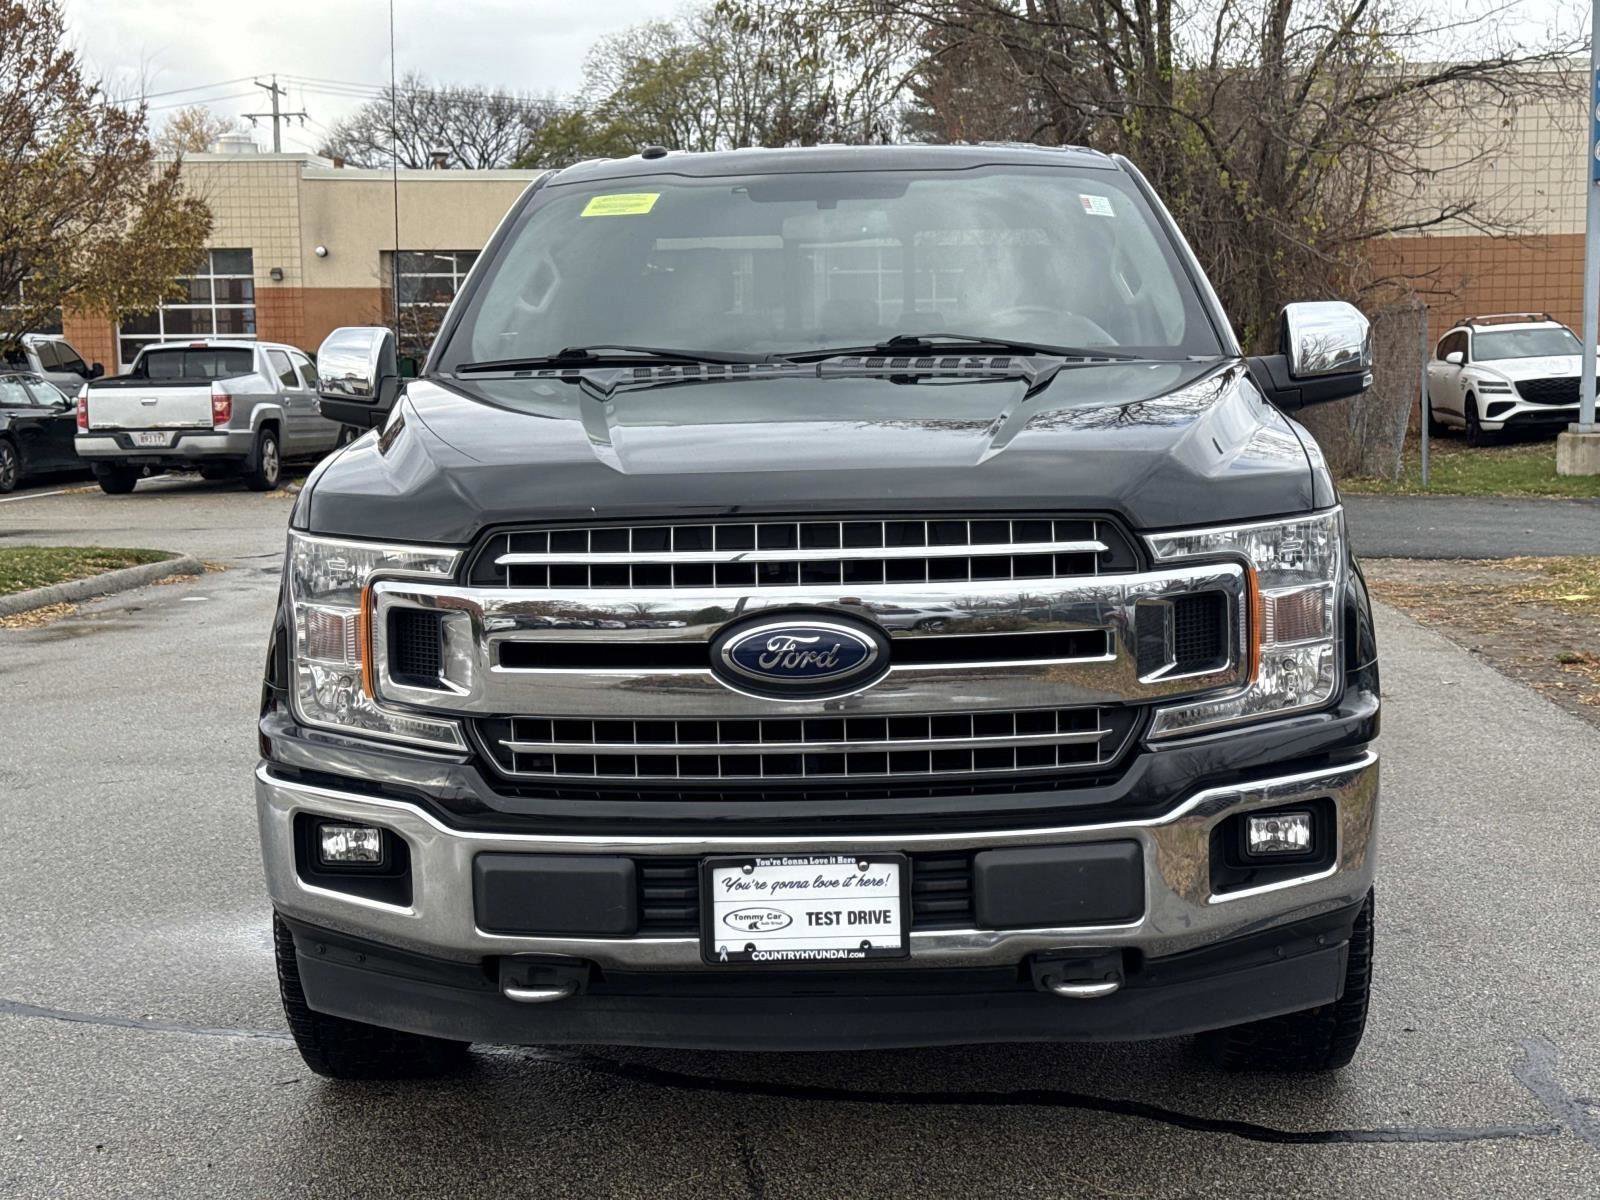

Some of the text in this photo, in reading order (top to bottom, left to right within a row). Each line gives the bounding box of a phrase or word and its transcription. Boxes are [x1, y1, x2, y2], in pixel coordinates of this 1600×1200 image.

[758, 635, 841, 669] Ford
[755, 858, 781, 867] You're
[782, 857, 808, 866] Gonna
[809, 857, 829, 865] Love
[837, 856, 856, 864] Here
[721, 873, 891, 896] You're gonna love it here!
[734, 914, 764, 922] Tommy
[805, 910, 892, 926] TEST DRIVE
